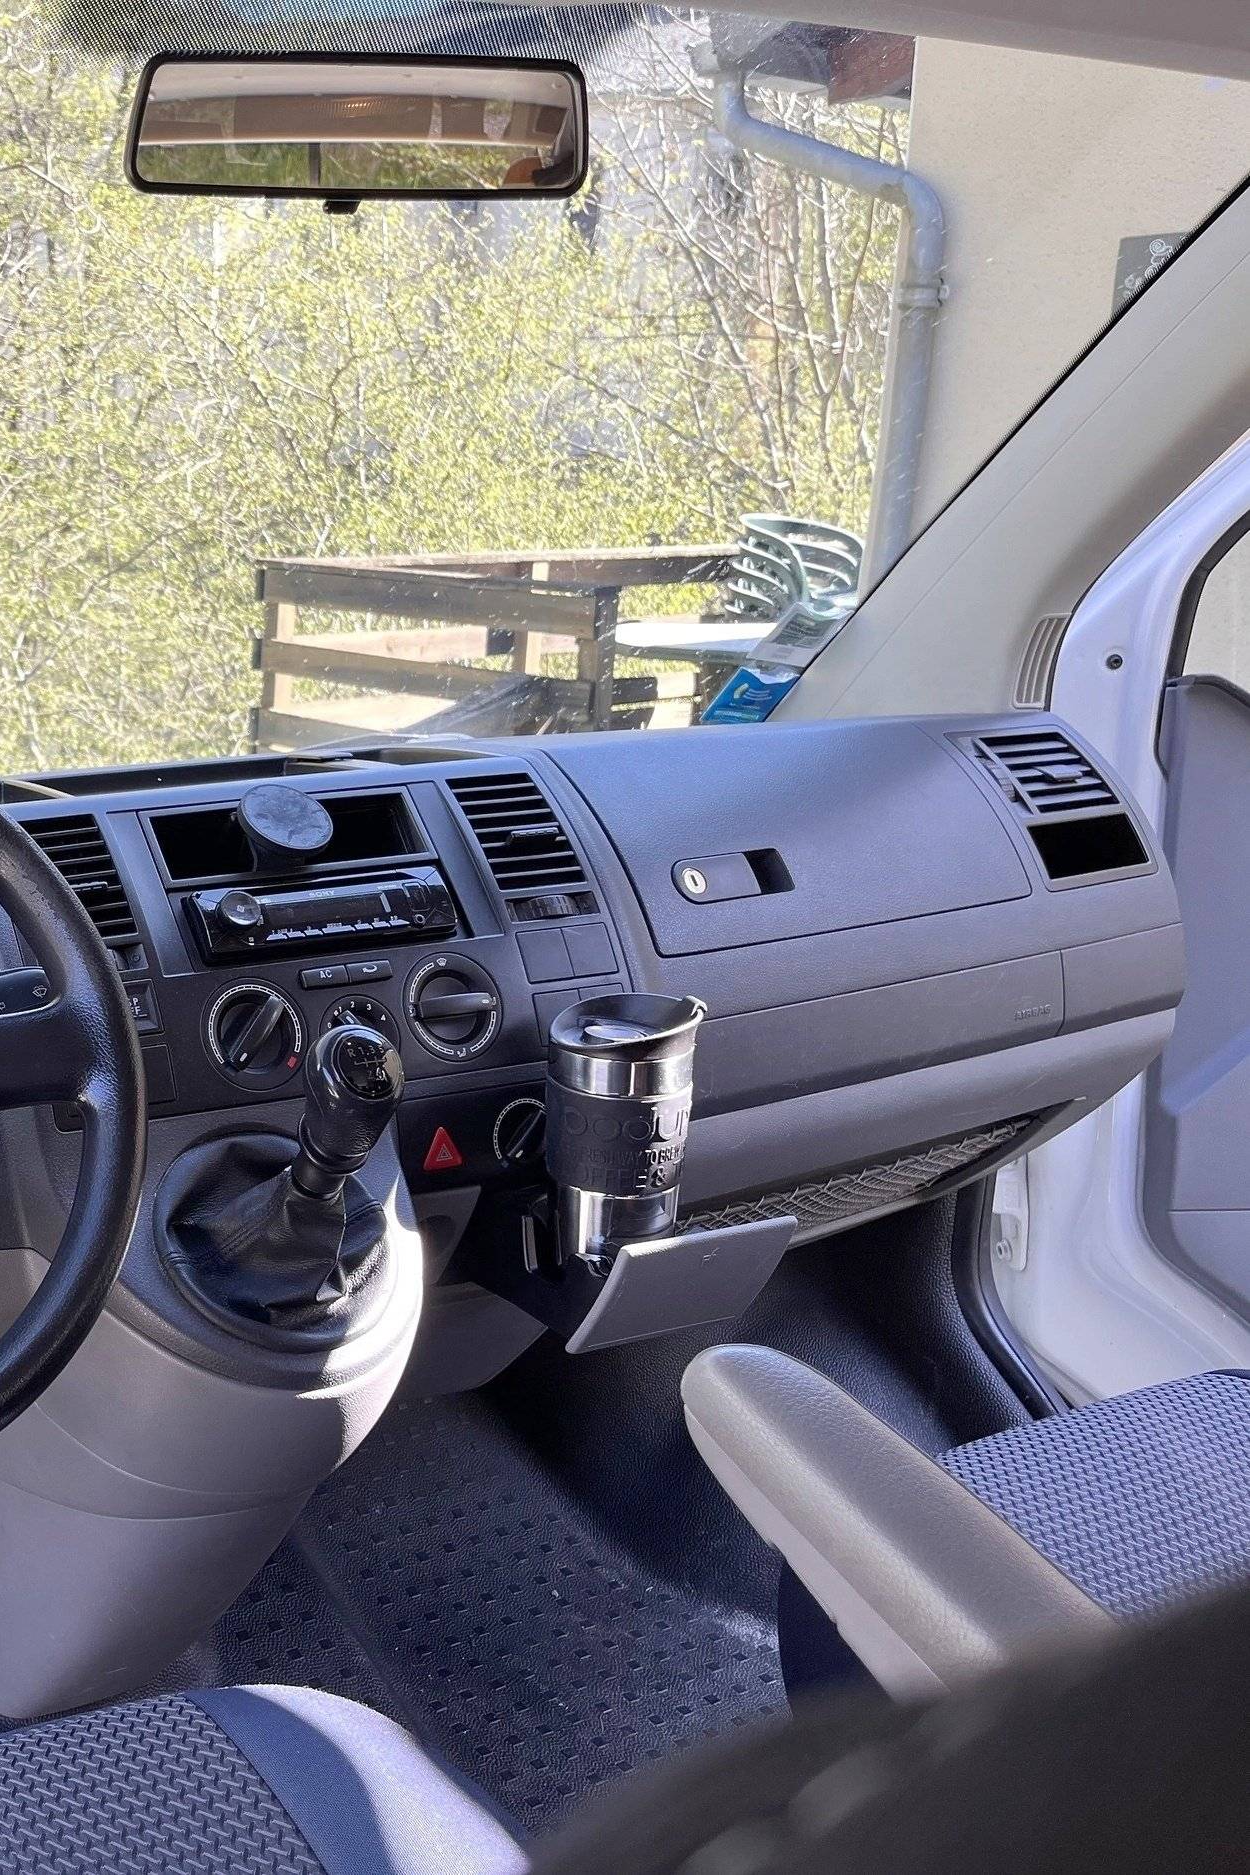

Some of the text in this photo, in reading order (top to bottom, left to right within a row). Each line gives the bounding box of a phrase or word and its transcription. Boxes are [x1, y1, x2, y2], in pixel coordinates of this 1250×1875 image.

[319, 968, 333, 980] AC
[366, 1003, 372, 1011] 3
[347, 1048, 356, 1058] R
